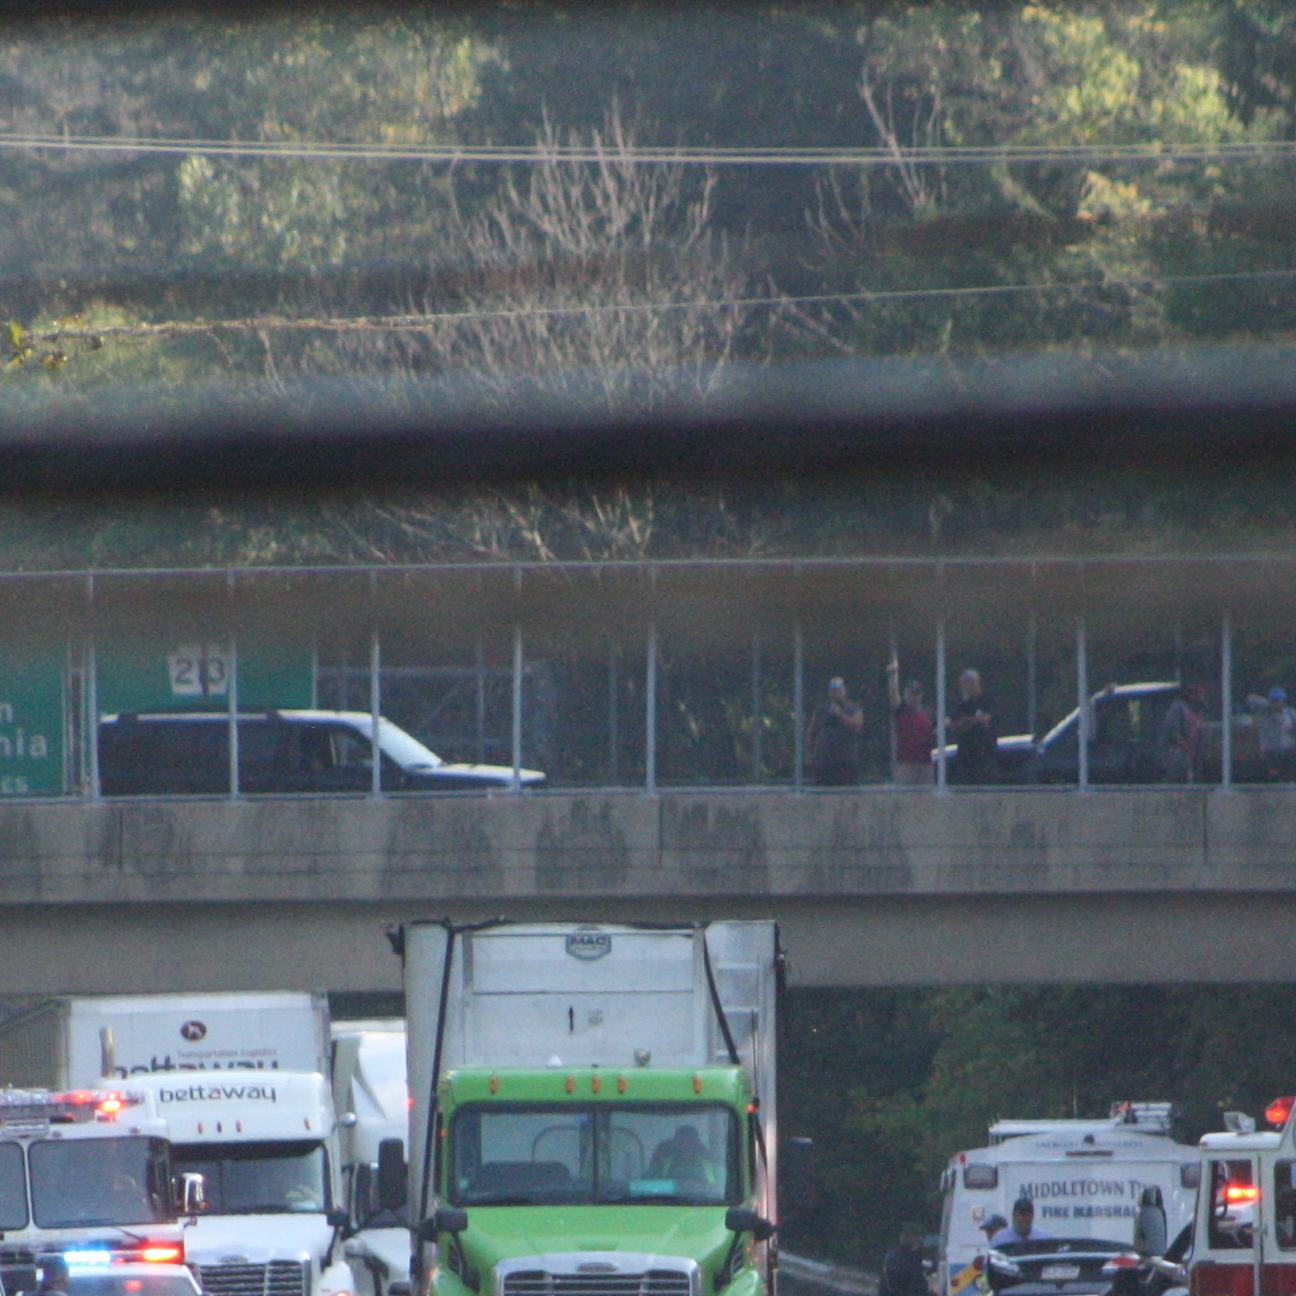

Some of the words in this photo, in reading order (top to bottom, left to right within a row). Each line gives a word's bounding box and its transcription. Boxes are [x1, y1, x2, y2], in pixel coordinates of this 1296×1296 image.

[160, 1085, 278, 1104] bettaway
[1019, 1179, 1124, 1200] MIDDLETOWN
[1041, 1205, 1070, 1219] FIRE
